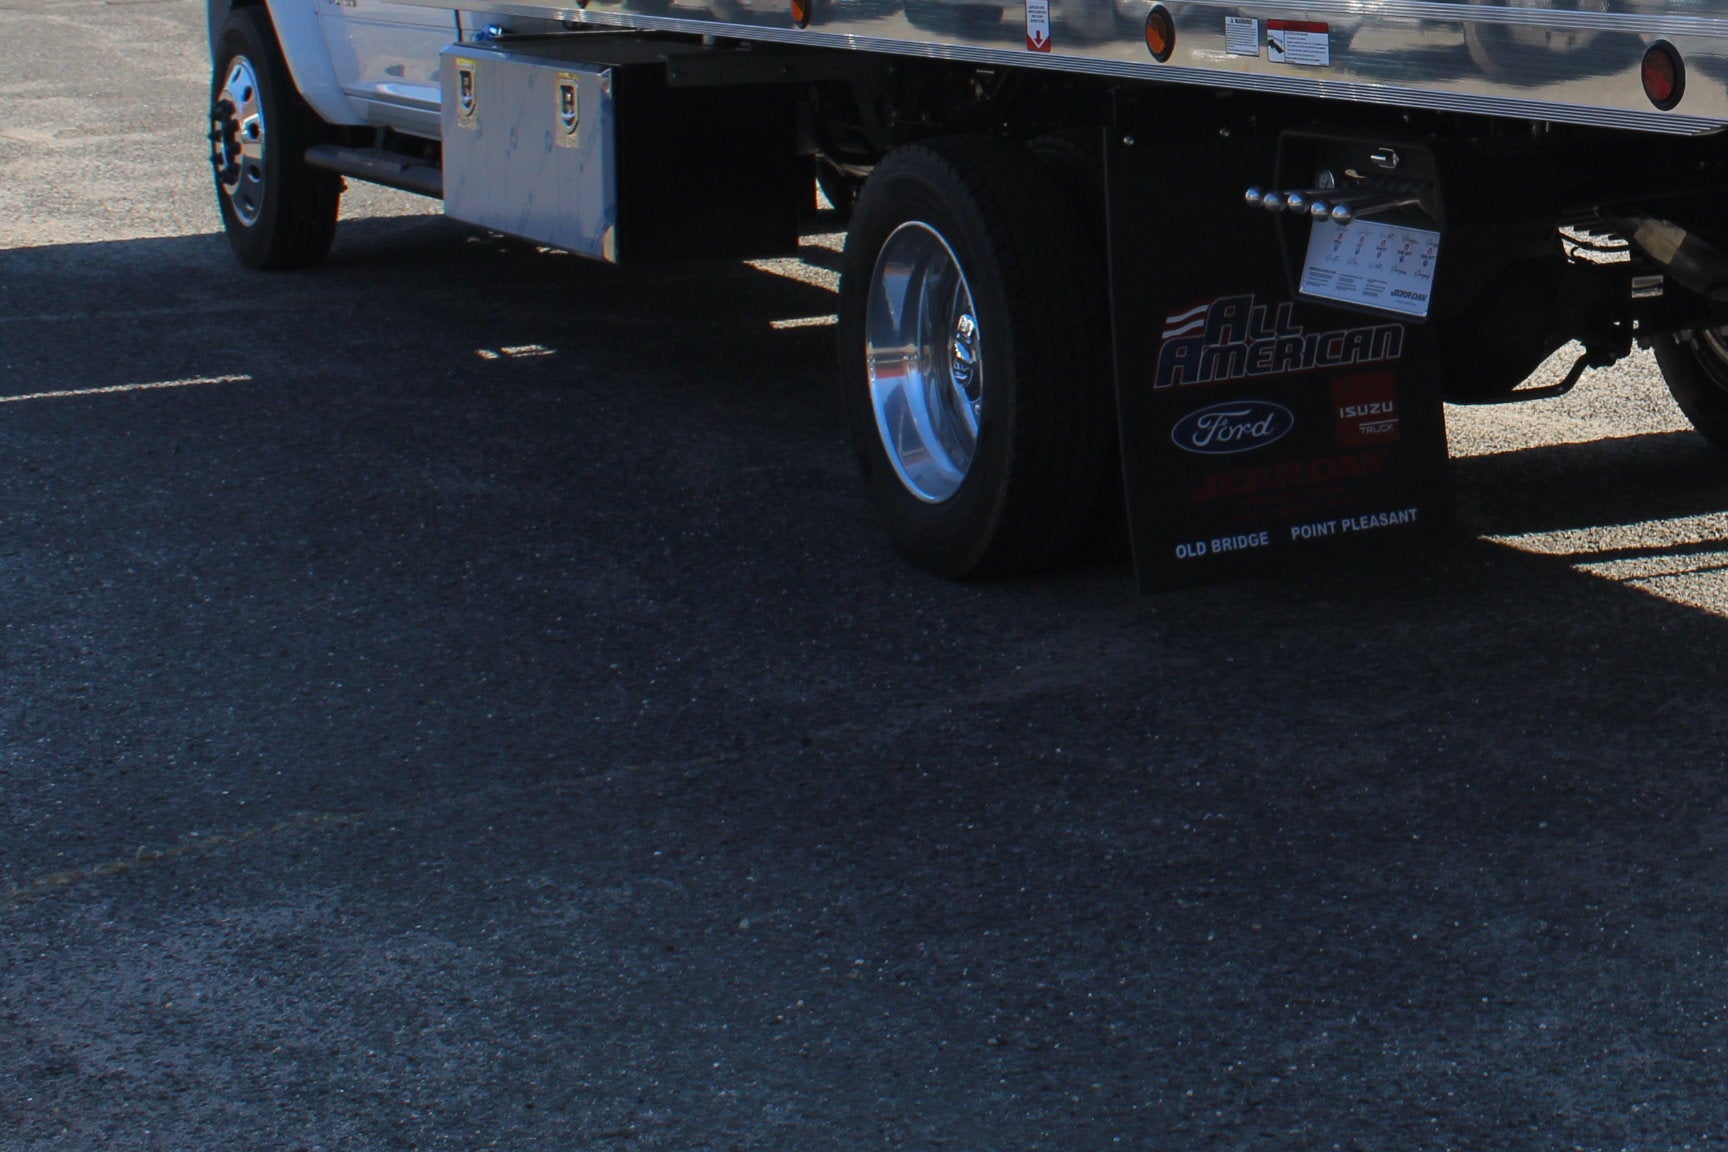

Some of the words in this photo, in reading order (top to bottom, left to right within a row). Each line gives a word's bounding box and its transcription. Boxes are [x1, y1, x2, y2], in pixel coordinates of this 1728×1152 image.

[1205, 294, 1304, 347] ALL
[1154, 323, 1405, 389] AMERICAN
[1192, 409, 1275, 447] Ford
[1339, 400, 1394, 419] ISUZU
[1359, 422, 1395, 435] TRUCK
[1175, 543, 1207, 559] OLD
[1211, 531, 1270, 554] BRIDGE
[1291, 520, 1337, 540] POINT
[1342, 508, 1418, 532] PLEASANT
